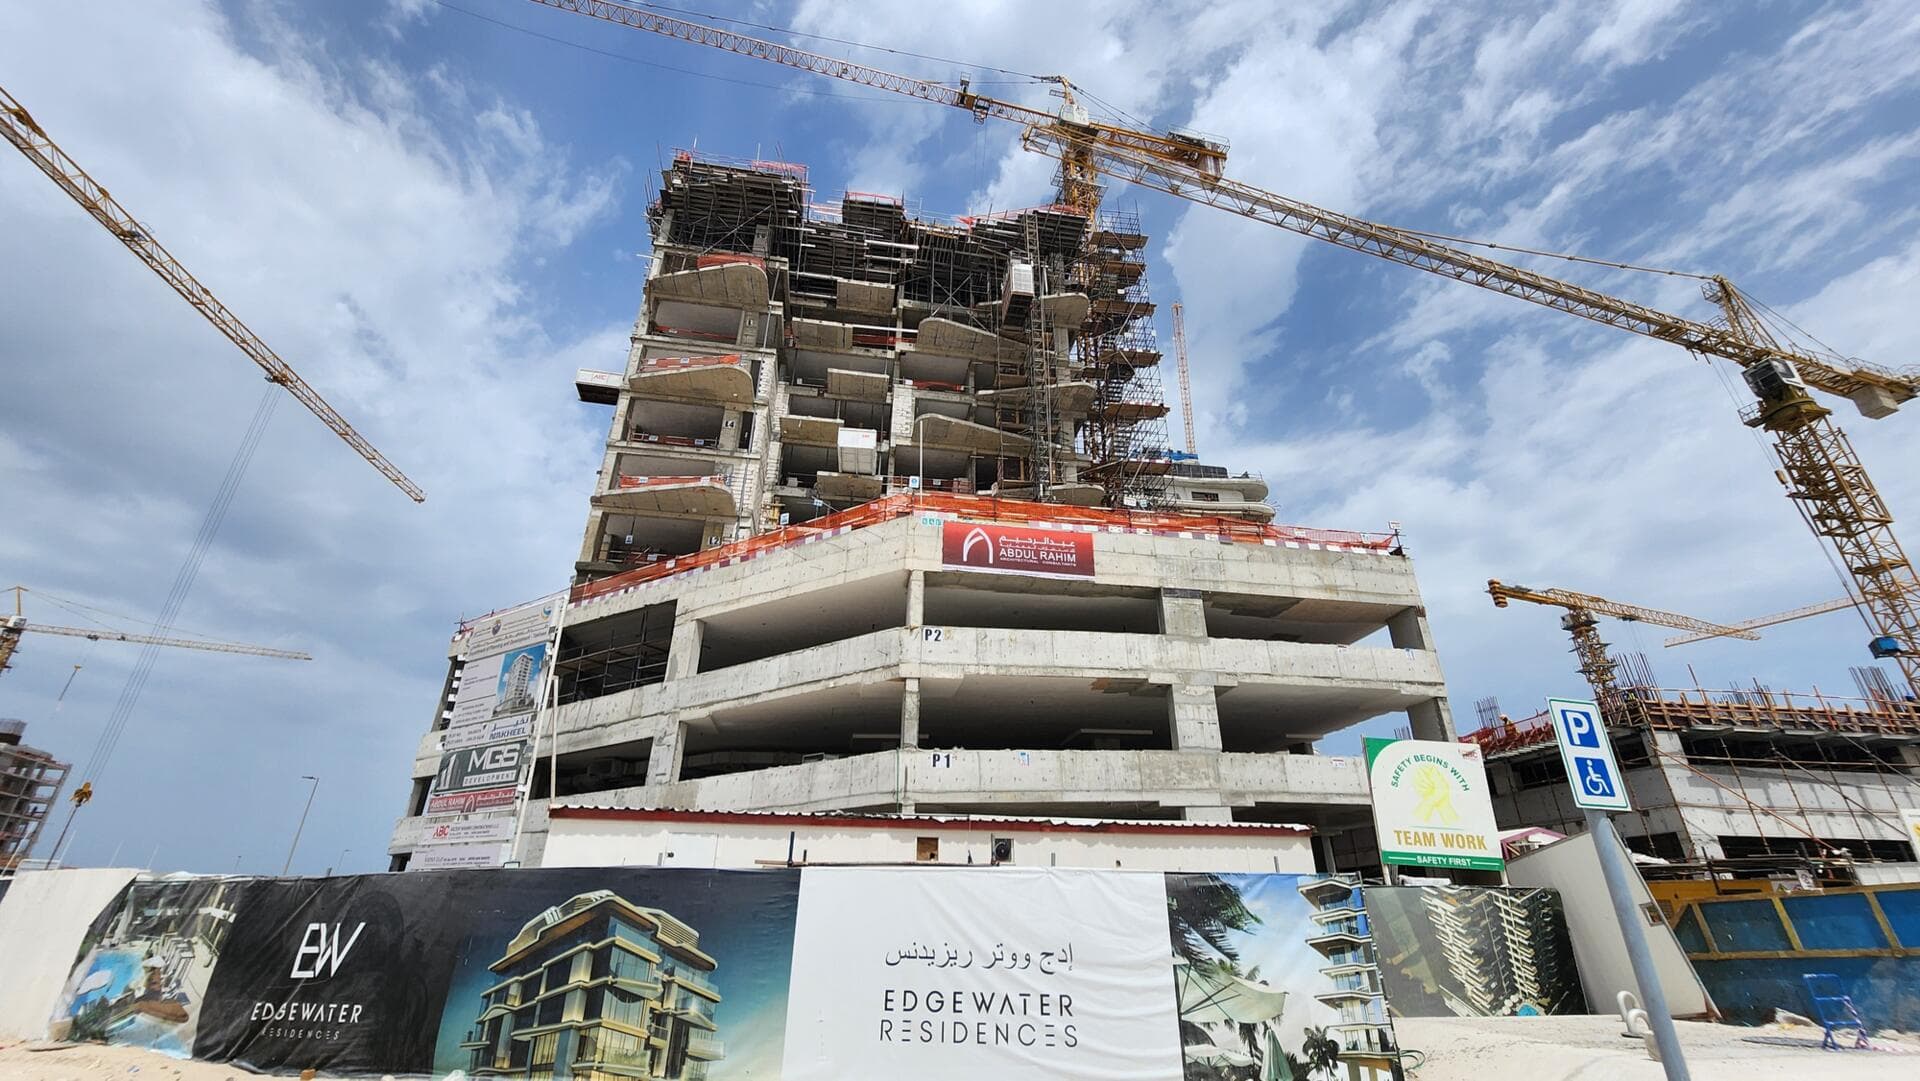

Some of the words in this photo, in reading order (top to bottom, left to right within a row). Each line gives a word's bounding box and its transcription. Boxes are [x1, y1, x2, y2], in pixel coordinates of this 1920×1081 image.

[999, 548, 1038, 560] ABDUL
[1040, 551, 1076, 563] RAHIM
[924, 629, 942, 641] P2
[489, 727, 526, 741] NAKHEEL
[1565, 711, 1590, 745] P
[467, 743, 520, 773] MGS
[932, 753, 951, 768] P1
[464, 771, 515, 784] DEVELOPMENT
[1391, 757, 1412, 788] SAFETY
[1413, 754, 1449, 769] BEGINS
[1450, 767, 1470, 792] WITH
[433, 825, 450, 837] ABC
[1393, 830, 1437, 848] TEAM
[1440, 832, 1488, 850] WORK
[1416, 855, 1447, 865] SAFETY
[1449, 857, 1472, 867] FIRST
[885, 942, 973, 968] ريزيدنس
[982, 943, 1031, 969] ووتر
[1039, 942, 1073, 975] إدج
[250, 1002, 363, 1024] EDGEWATER
[884, 989, 1074, 1017] EDGEWATER
[880, 1019, 1078, 1048] RESIDENCES
